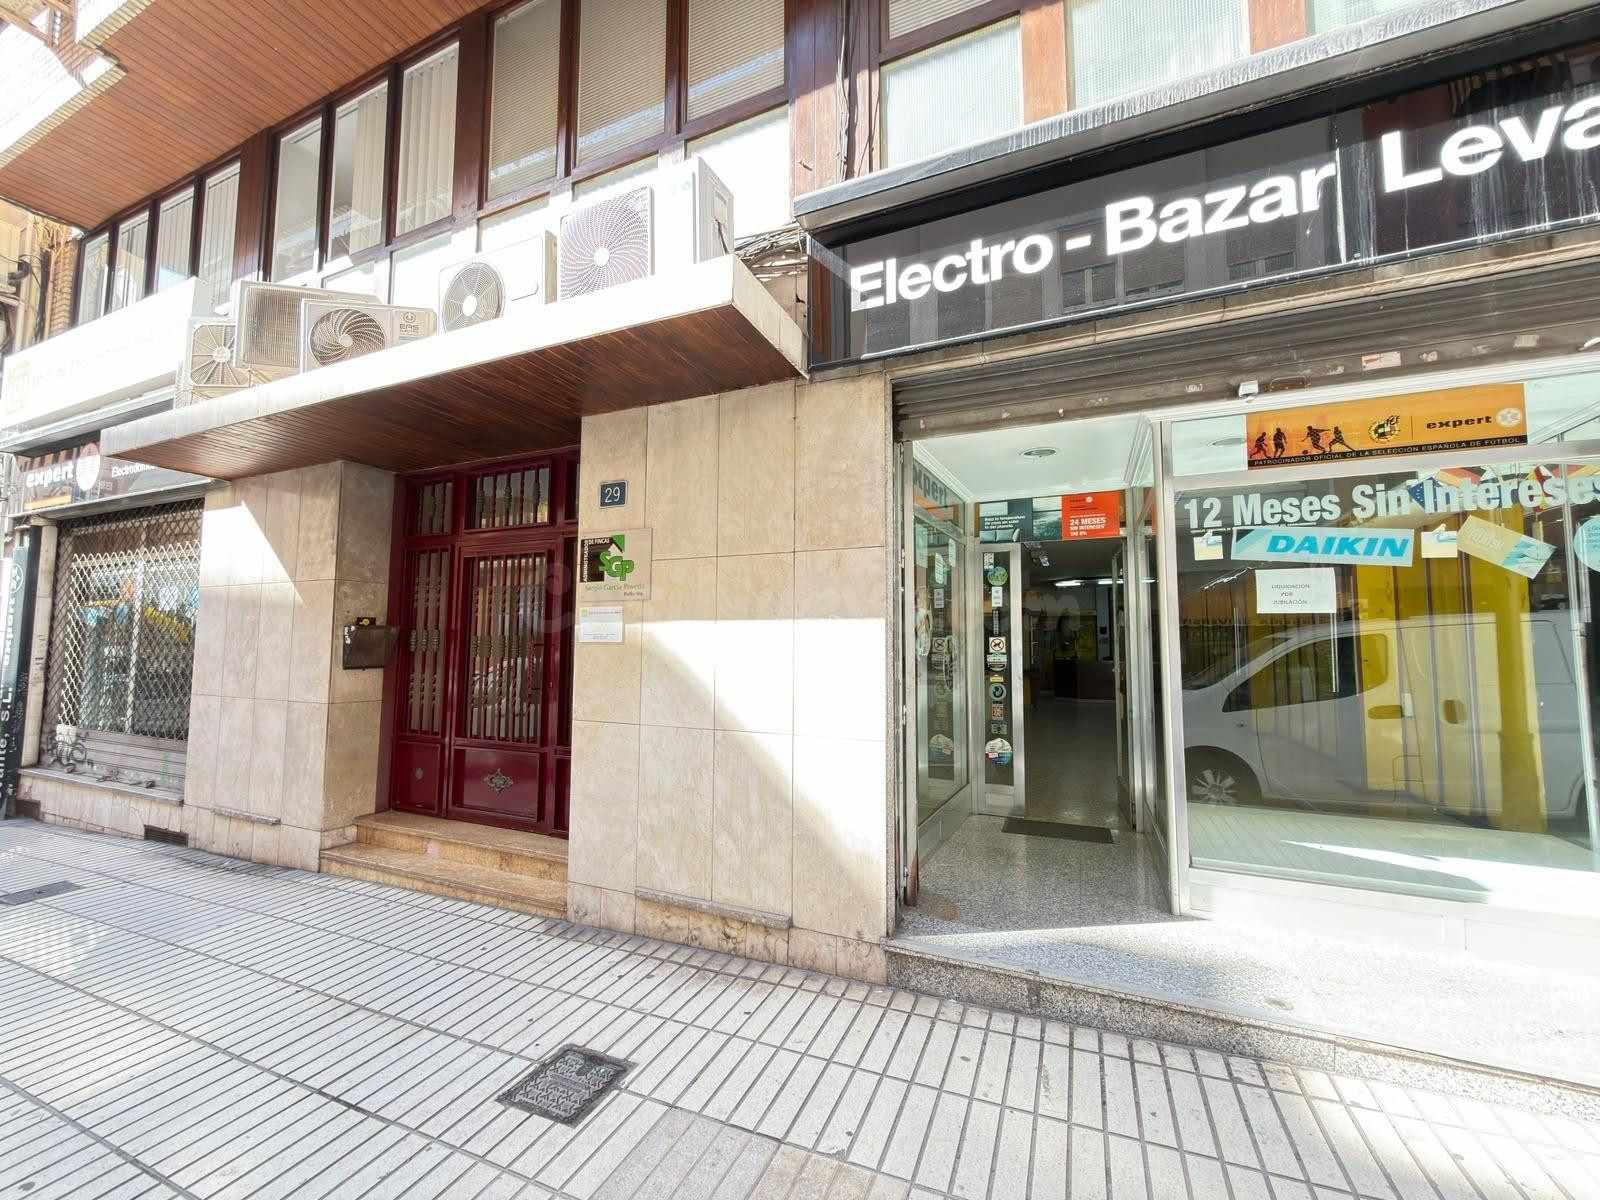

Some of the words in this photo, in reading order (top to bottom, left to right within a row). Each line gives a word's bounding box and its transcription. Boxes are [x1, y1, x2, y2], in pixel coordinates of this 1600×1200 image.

[850, 233, 1054, 313] Electro
[1066, 234, 1092, 250] -
[1105, 160, 1337, 257] Bazar
[1426, 415, 1493, 430] expert
[1254, 455, 1311, 466] PATROCINADOR
[1313, 453, 1343, 461] OFICIAL
[1372, 446, 1419, 456] SELECCIÓN
[1421, 442, 1467, 451] ESPAÑOLA
[25, 460, 74, 488] expert
[604, 486, 621, 503] 29
[1184, 497, 1223, 529] 12
[1232, 492, 1341, 527] Meses
[1351, 482, 1411, 519] Sin
[1081, 517, 1106, 525] MESES
[1266, 534, 1410, 559] DAIKIN
[585, 583, 603, 592] Sergio
